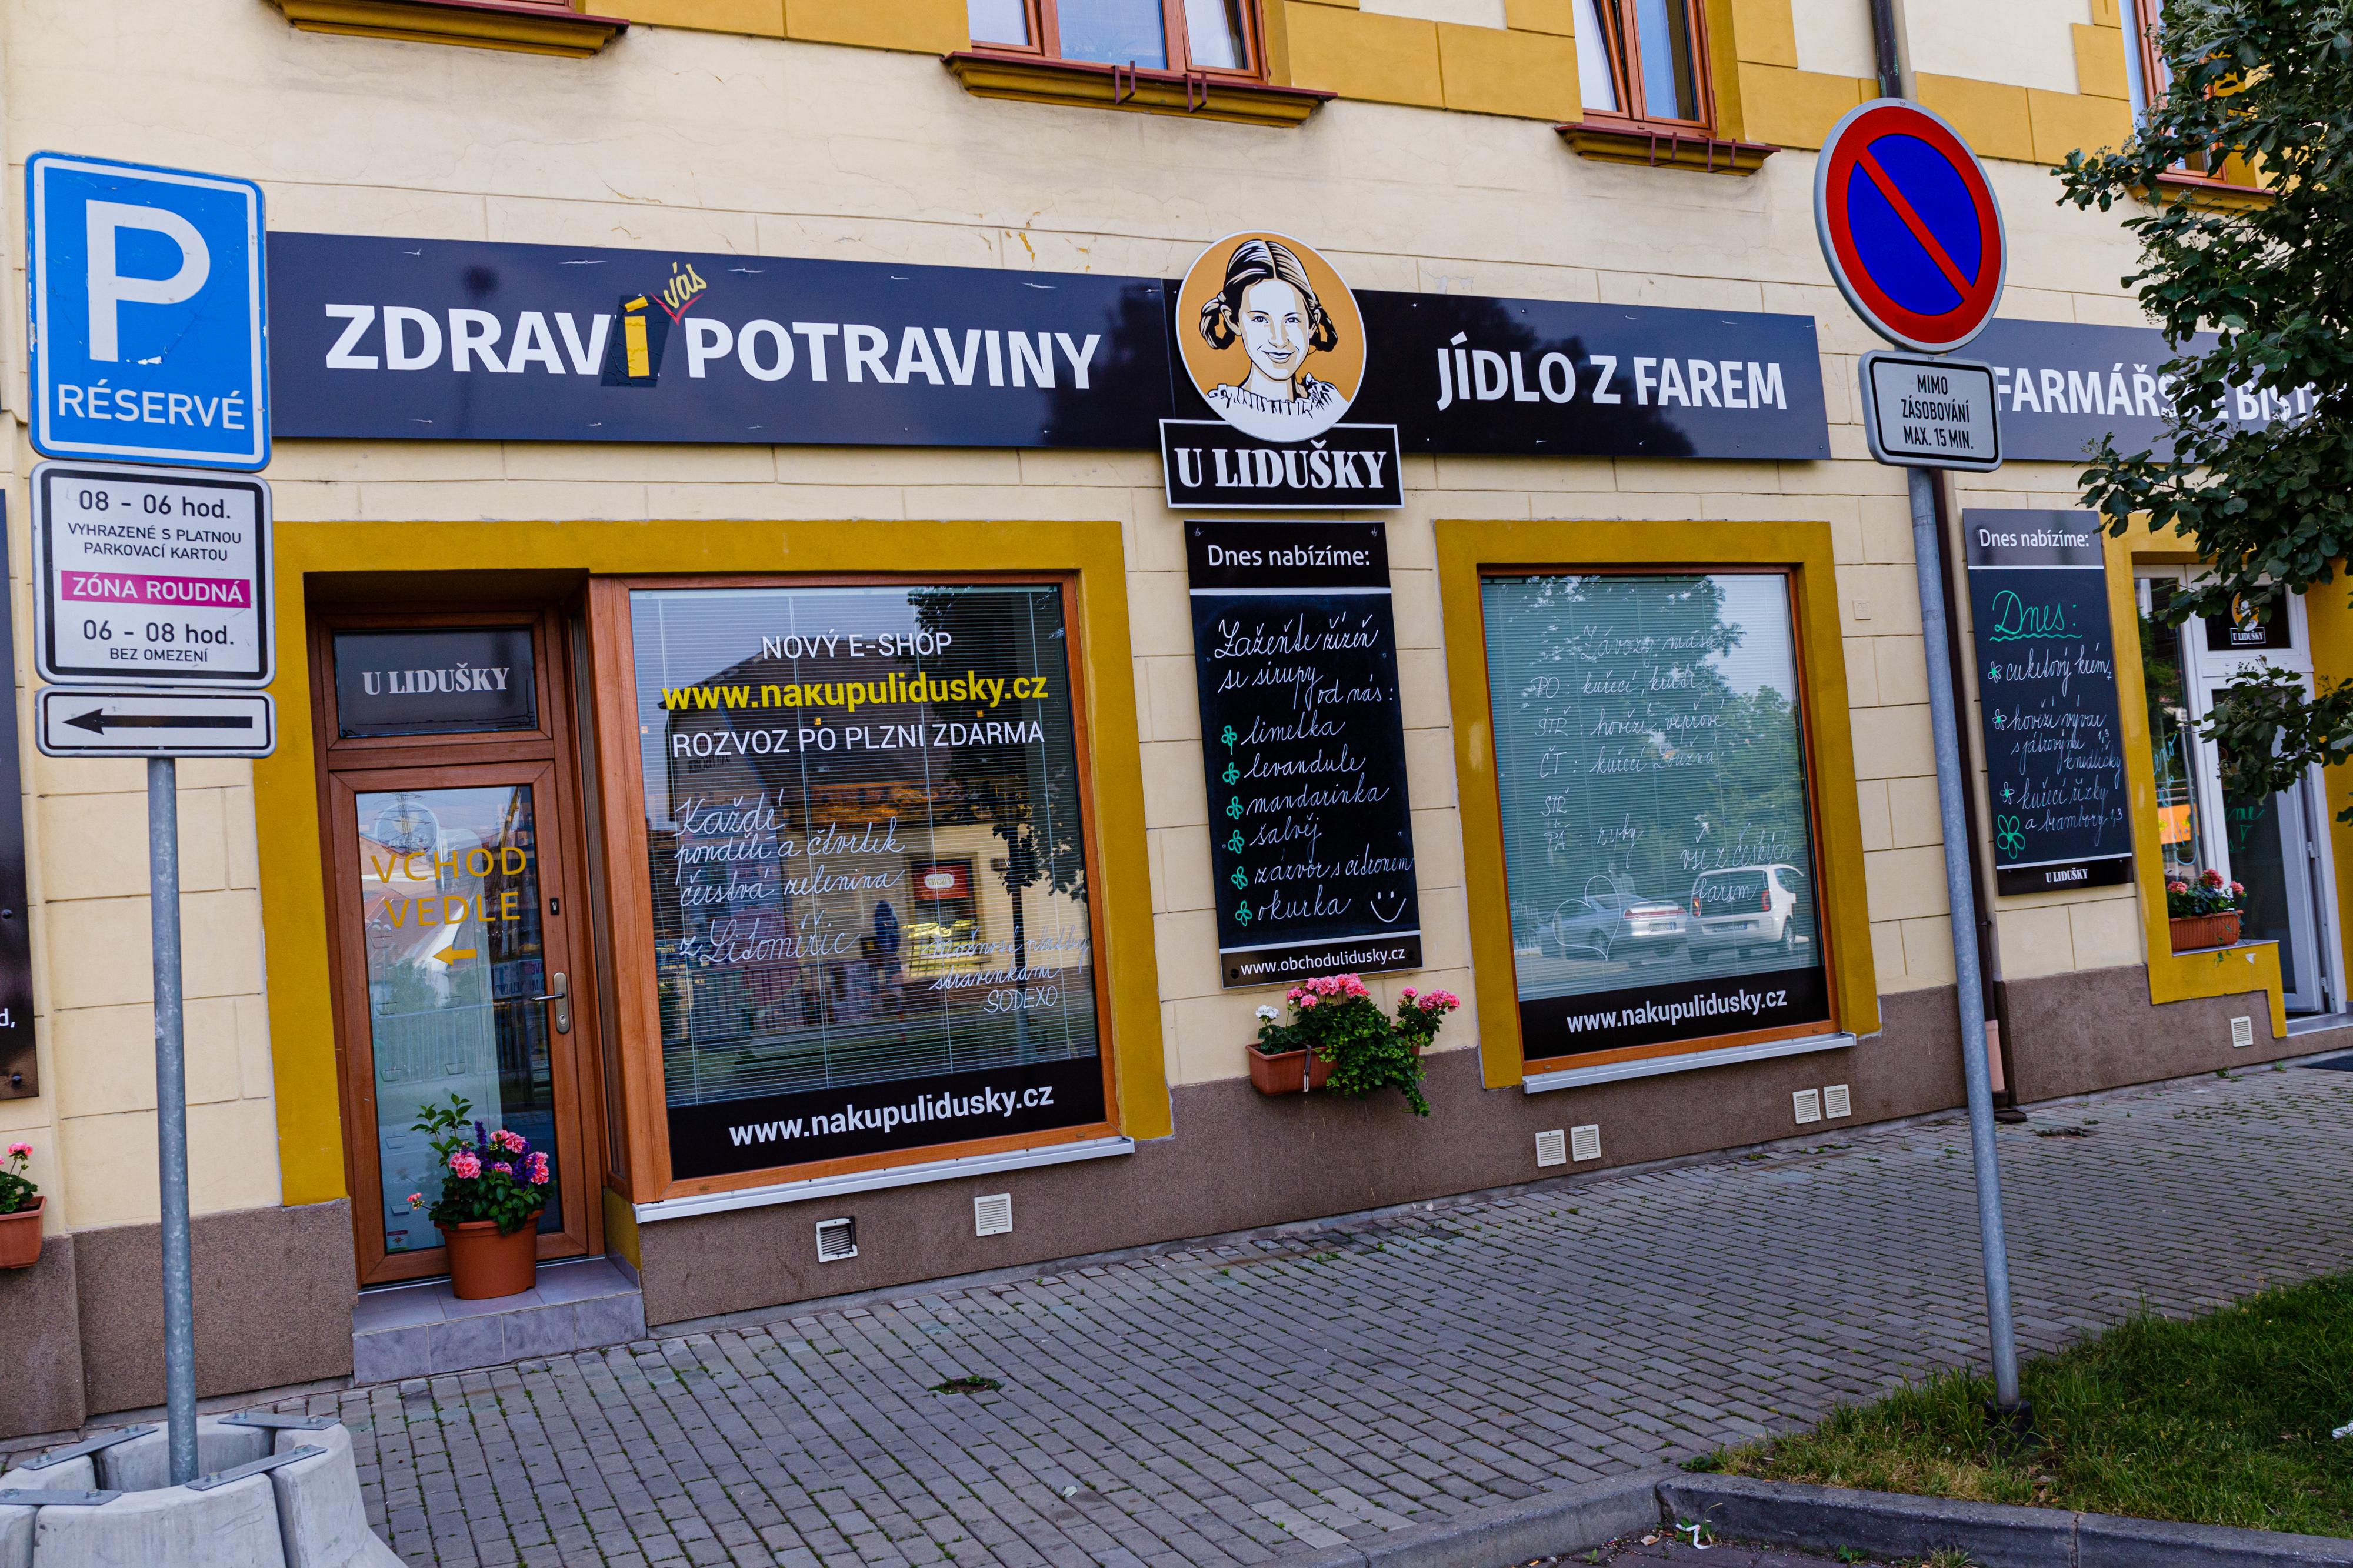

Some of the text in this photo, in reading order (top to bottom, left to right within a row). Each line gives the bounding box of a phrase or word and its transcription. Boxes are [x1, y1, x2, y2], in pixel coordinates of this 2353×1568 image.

[86, 199, 210, 362] P
[685, 317, 1101, 389] POTRAVINY
[1437, 331, 1787, 411] JÍDLO Z FAREM
[1917, 374, 1948, 395] MIMO
[58, 379, 245, 430] RÉSERVÉ
[1901, 395, 1969, 423] ZÁSOBOVÁNÍ
[1903, 425, 1974, 449] MAX. 15 MIN.
[1174, 439, 1387, 489] U LIDUŠKY
[79, 490, 108, 511] 08
[144, 494, 171, 515] 06
[182, 496, 231, 519] hod.
[68, 523, 241, 543] VYHRAZENÉ S PLATNOU
[1979, 529, 2089, 548] Dnes nabízíme:
[84, 542, 228, 561] PARKOVACÍ KARTOU
[1208, 544, 1370, 566] Dnes nabízíme:
[72, 574, 243, 603] ZÓNA ROUDNÁ
[83, 620, 112, 640] 06
[146, 622, 175, 643] 08
[186, 625, 234, 645] hod.
[762, 628, 952, 659] NOVÝ E-SHOP
[1214, 612, 1378, 658] Zažeňte žízeň
[110, 648, 208, 662] BEZ OMEZENÍ
[2006, 647, 2072, 697] cuketový
[362, 663, 509, 695] U LIDUŠKY
[662, 670, 1048, 712] www.nakupulidusky.cz
[1218, 661, 1324, 711] se sirupy
[1317, 680, 1343, 704] od
[672, 729, 794, 758] ROZVOZ
[799, 728, 836, 752] PO
[846, 724, 924, 750] PLZNI
[933, 721, 1045, 746] ZDARMA
[1241, 710, 1345, 745] limetka
[1244, 743, 1365, 778] levandule
[1247, 773, 1389, 815] mandarinka
[673, 789, 785, 836] Každé
[2025, 819, 2037, 829] a
[371, 847, 526, 883] VCHOD
[675, 816, 905, 886] pondělí a čtvrtek
[1255, 848, 1330, 884] zázvor
[681, 865, 905, 906] čerstvá zelenina
[2045, 867, 2088, 883] U LIDUŠKY
[384, 892, 521, 928] VEDLE
[1258, 885, 1351, 920] okurka
[680, 935, 703, 956] z
[1241, 948, 1405, 975] www.obchodulidusky.cz
[984, 986, 1058, 1013] SODEXO
[1567, 989, 1787, 1033] www.nakupulidusky.cz
[729, 1085, 1054, 1146] www.nakupulidusky.cz
